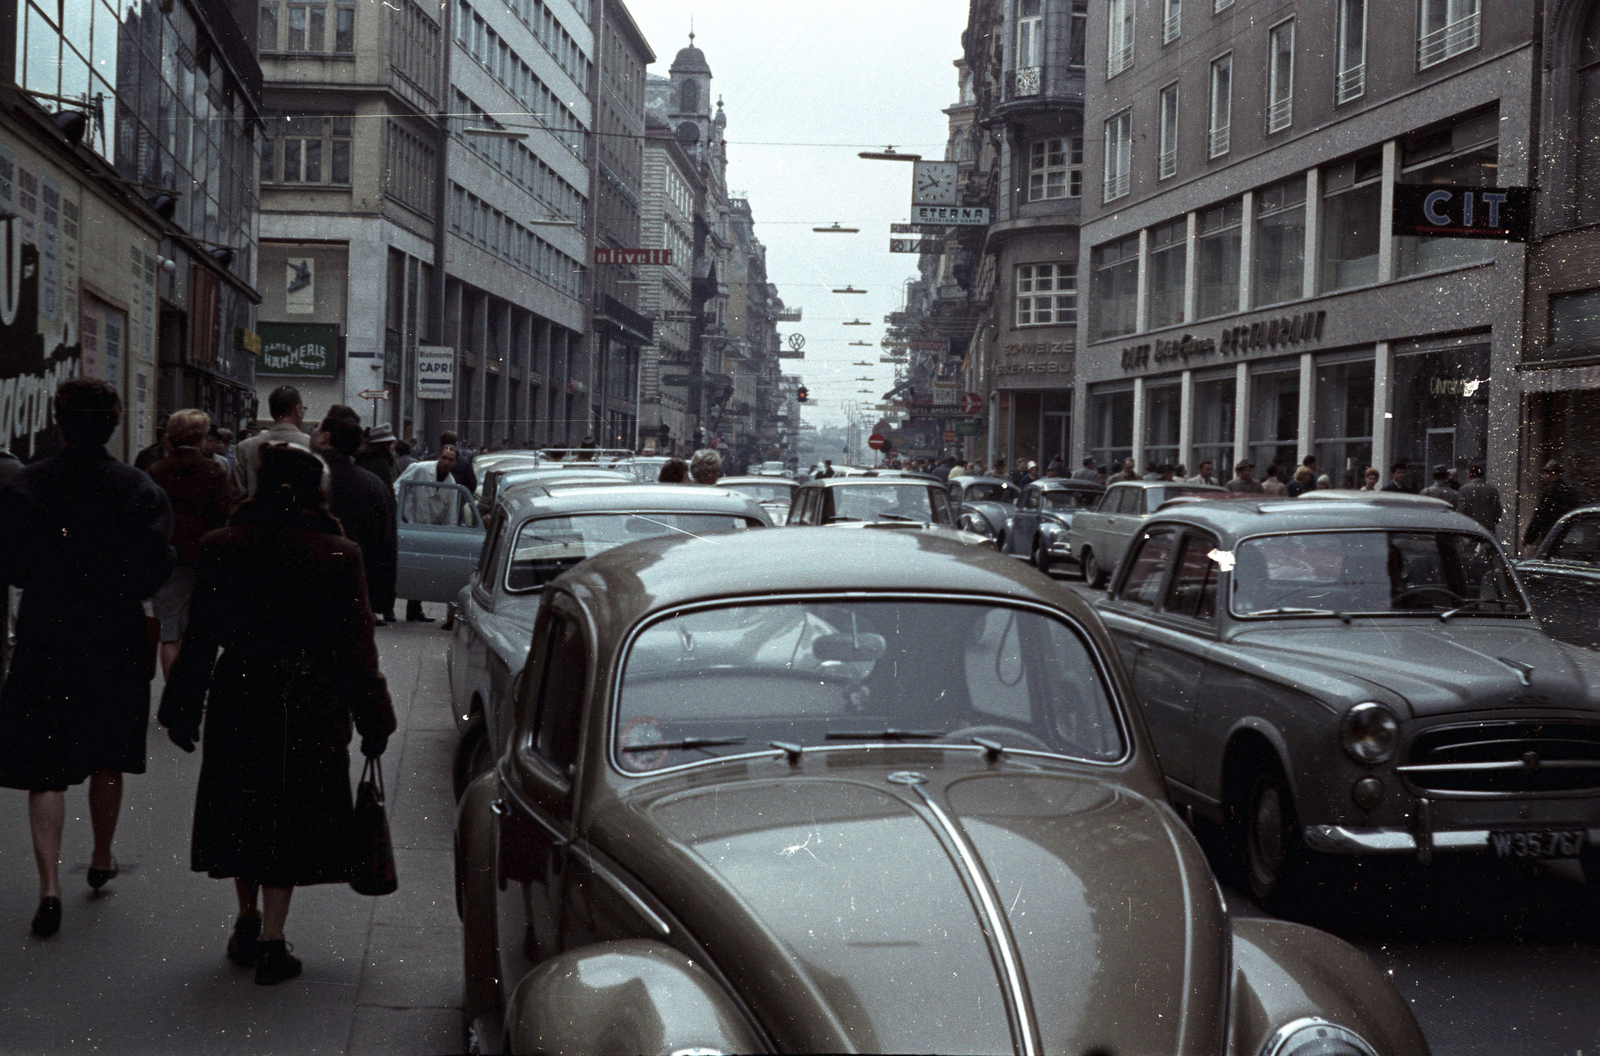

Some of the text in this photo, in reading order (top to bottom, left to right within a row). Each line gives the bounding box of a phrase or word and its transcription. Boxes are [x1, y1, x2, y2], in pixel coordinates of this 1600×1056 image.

[919, 207, 984, 219] ETERNA
[1423, 189, 1507, 228] CIT
[597, 249, 673, 264] olivetti
[264, 342, 292, 353] DAMEN
[1004, 341, 1076, 357] SCHWEIZE
[419, 362, 453, 374] CAPRI
